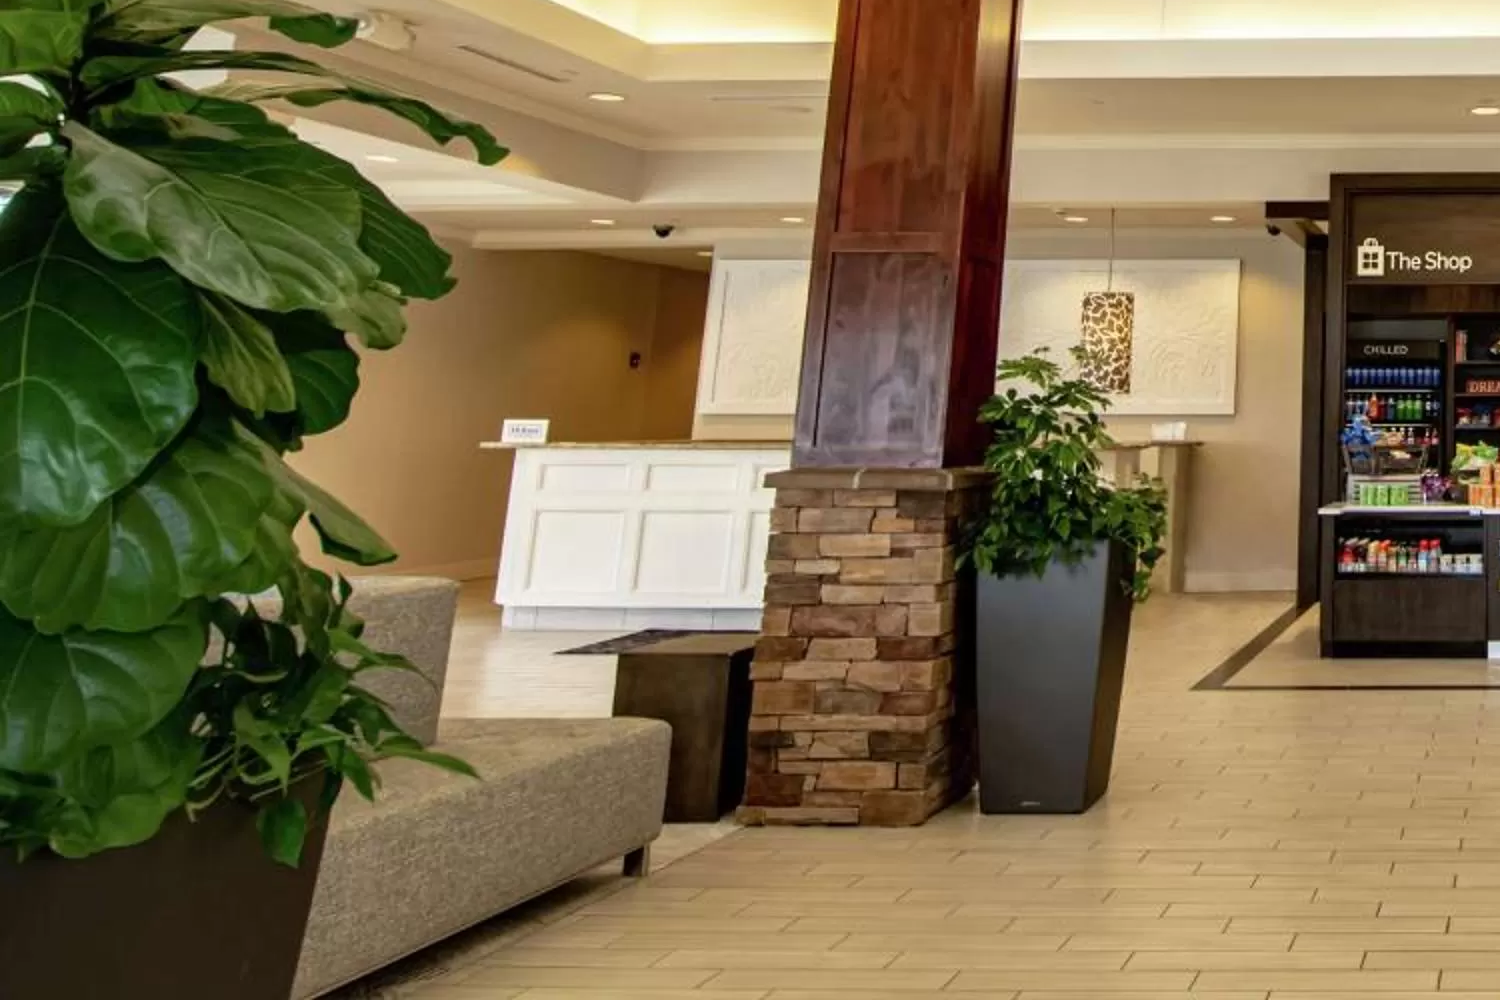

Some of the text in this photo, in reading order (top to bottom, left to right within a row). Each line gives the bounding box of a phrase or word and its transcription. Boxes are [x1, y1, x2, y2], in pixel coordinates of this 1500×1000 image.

[1386, 251, 1473, 273] The Shop
[1363, 344, 1409, 356] CHILLED
